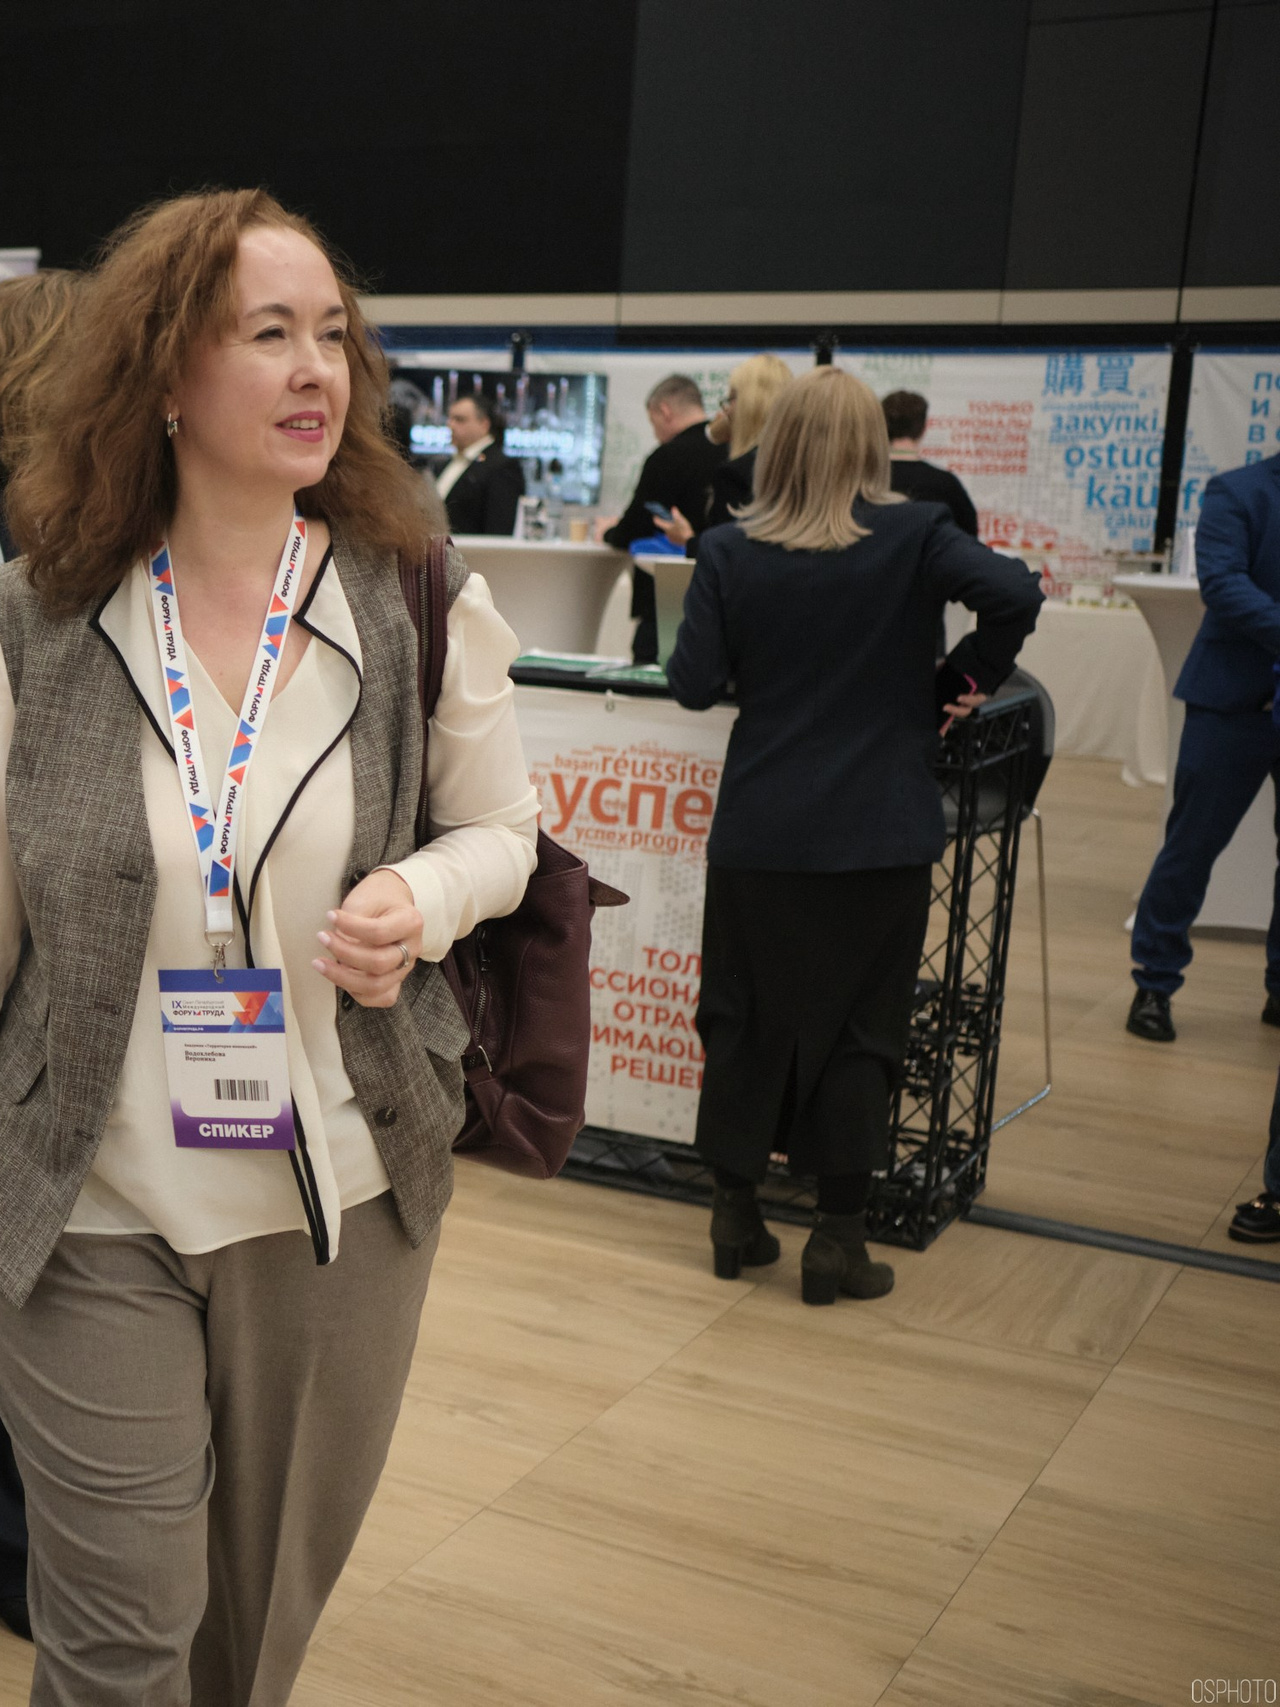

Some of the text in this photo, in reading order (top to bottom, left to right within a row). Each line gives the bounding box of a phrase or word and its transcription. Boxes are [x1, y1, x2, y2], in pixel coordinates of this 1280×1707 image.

[290, 536, 301, 562] ТРУДА
[165, 630, 177, 661] ТРУДА
[257, 659, 272, 687] ТРУДА
[187, 764, 200, 796] ТРУДА
[601, 750, 718, 789] réussite
[225, 785, 237, 815] ТРУДА
[631, 830, 707, 857] progre
[171, 1000, 182, 1009] IX
[198, 1123, 275, 1139] СПИКЕР
